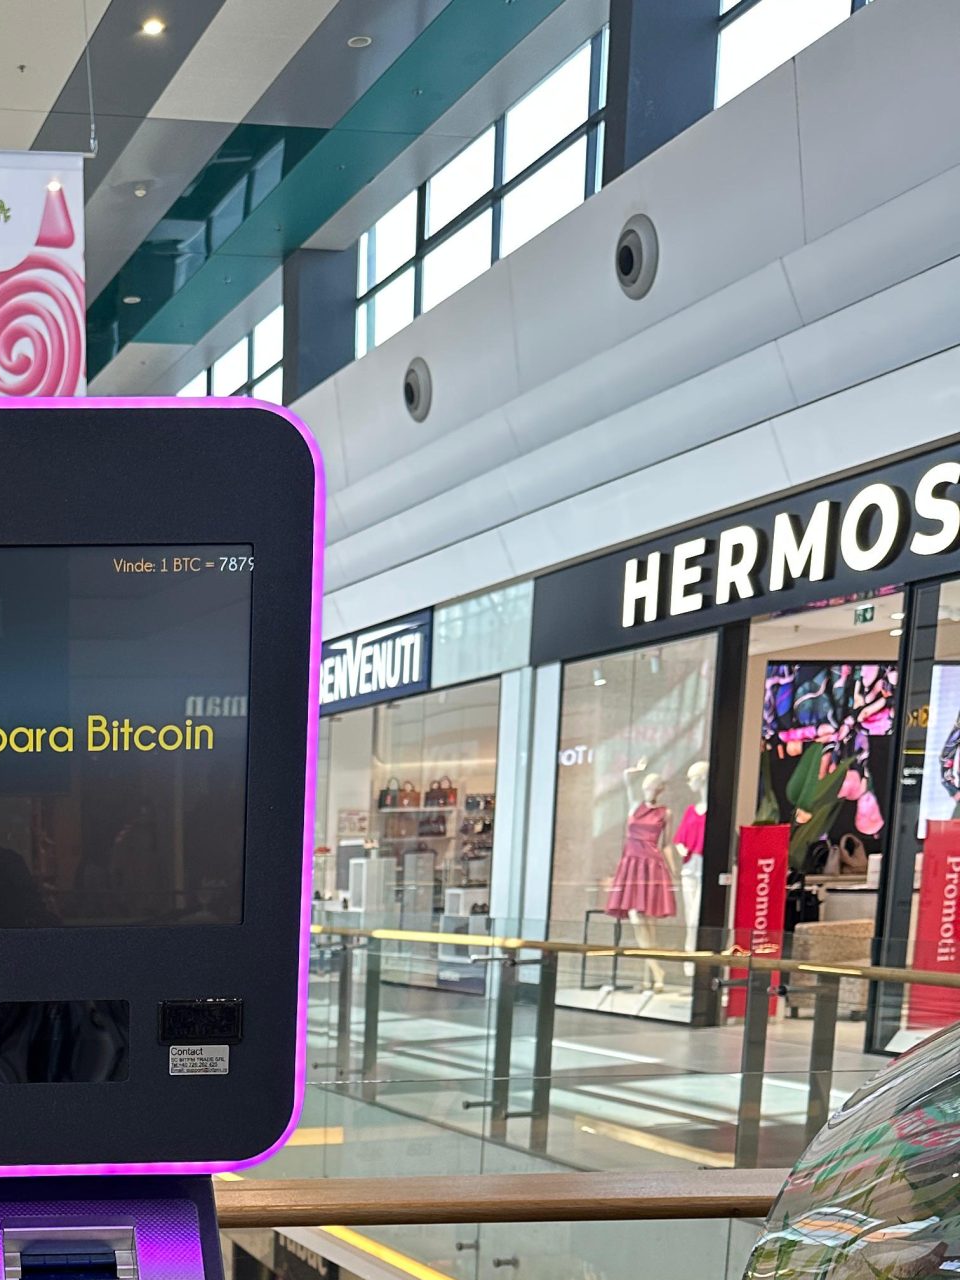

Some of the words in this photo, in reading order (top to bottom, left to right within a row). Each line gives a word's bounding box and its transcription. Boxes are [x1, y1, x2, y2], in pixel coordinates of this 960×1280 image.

[622, 461, 960, 628] HERMOS
[113, 558, 156, 573] Vinde:
[160, 558, 168, 572] 1
[173, 557, 201, 572] BTC
[319, 626, 422, 705] ENVENUTI
[87, 715, 215, 752] Bitcoin
[170, 1047, 203, 1056] Contact
